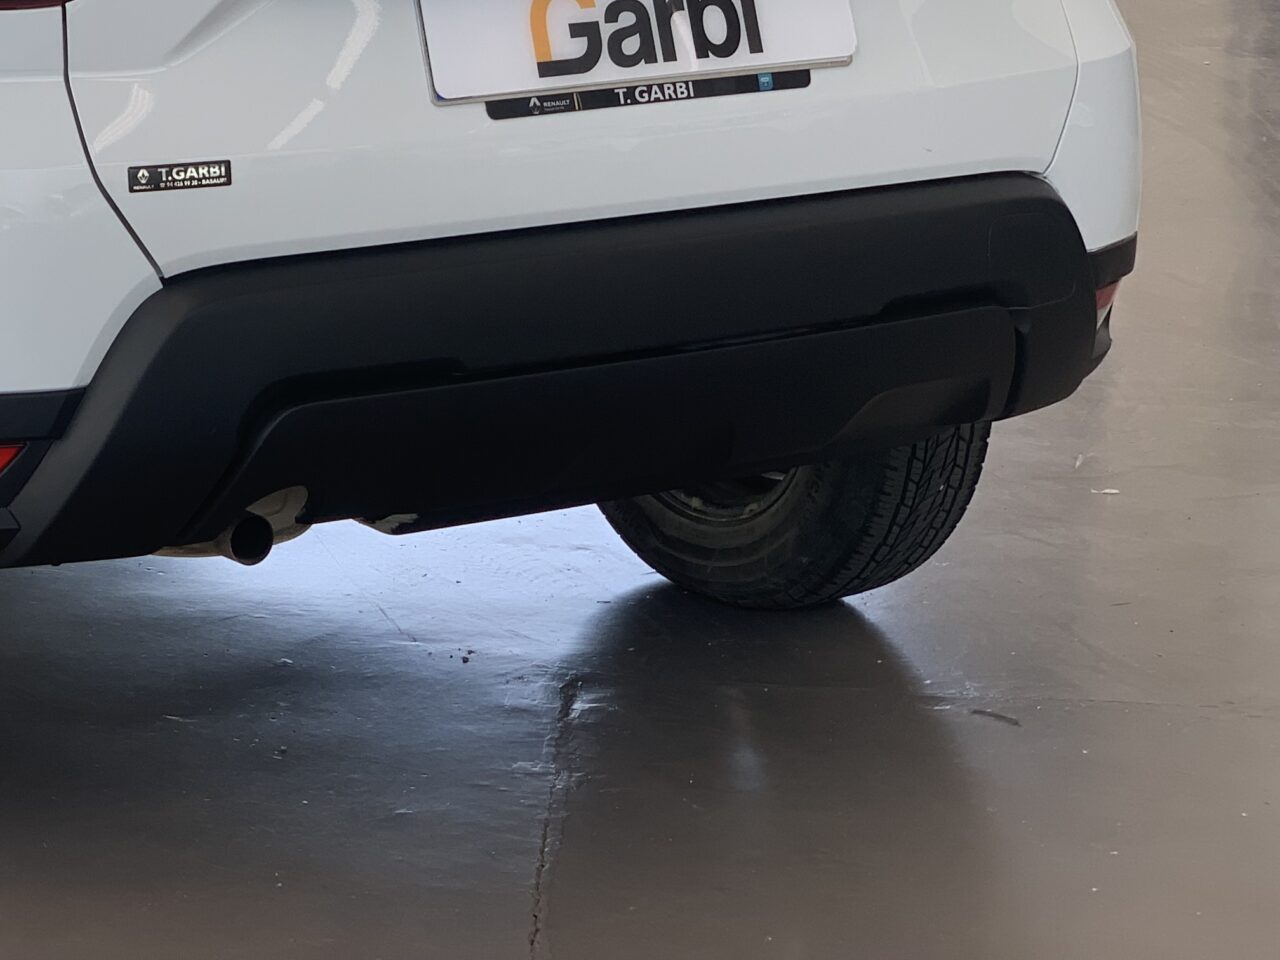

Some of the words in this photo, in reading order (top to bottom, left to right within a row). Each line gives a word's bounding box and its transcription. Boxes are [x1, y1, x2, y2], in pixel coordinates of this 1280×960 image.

[614, 87, 631, 105] T.
[635, 81, 695, 102] GARBI
[158, 164, 226, 181] T.GARBI
